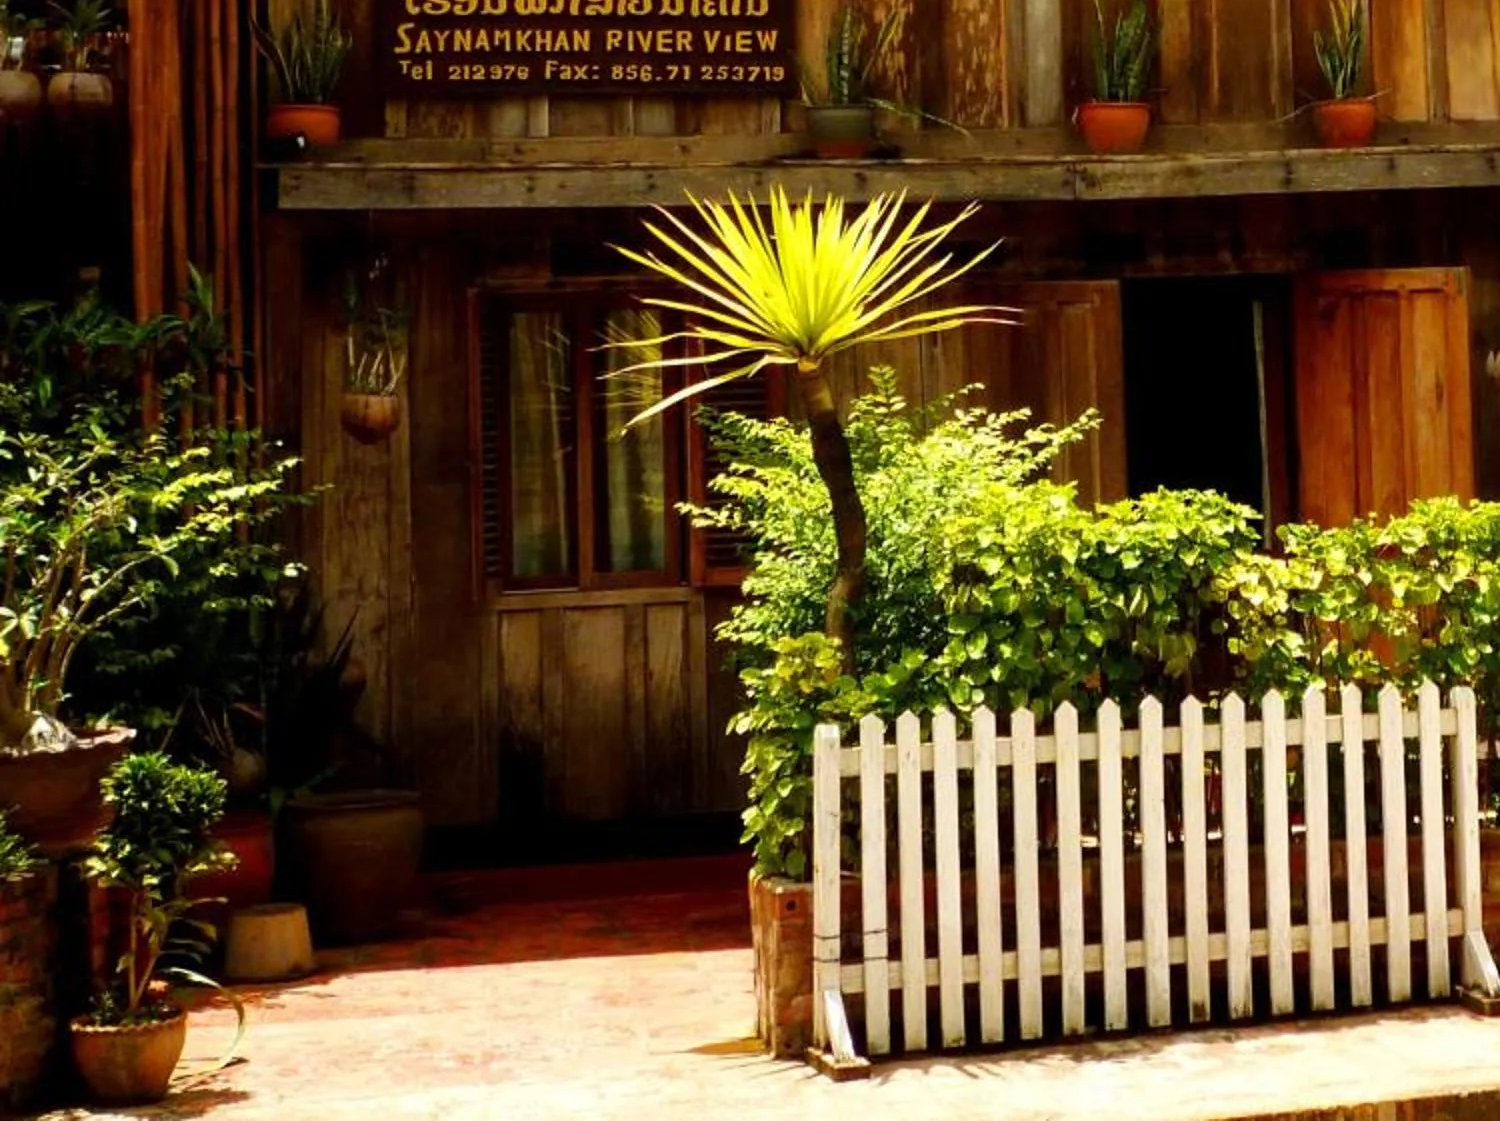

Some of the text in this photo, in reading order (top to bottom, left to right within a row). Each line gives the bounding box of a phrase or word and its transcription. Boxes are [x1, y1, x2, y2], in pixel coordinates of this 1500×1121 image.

[394, 22, 778, 54] SAYNAMKHAN RIVER VIEW
[399, 59, 433, 80] Tel
[545, 59, 600, 80] Fax:
[701, 65, 785, 82] 253719
